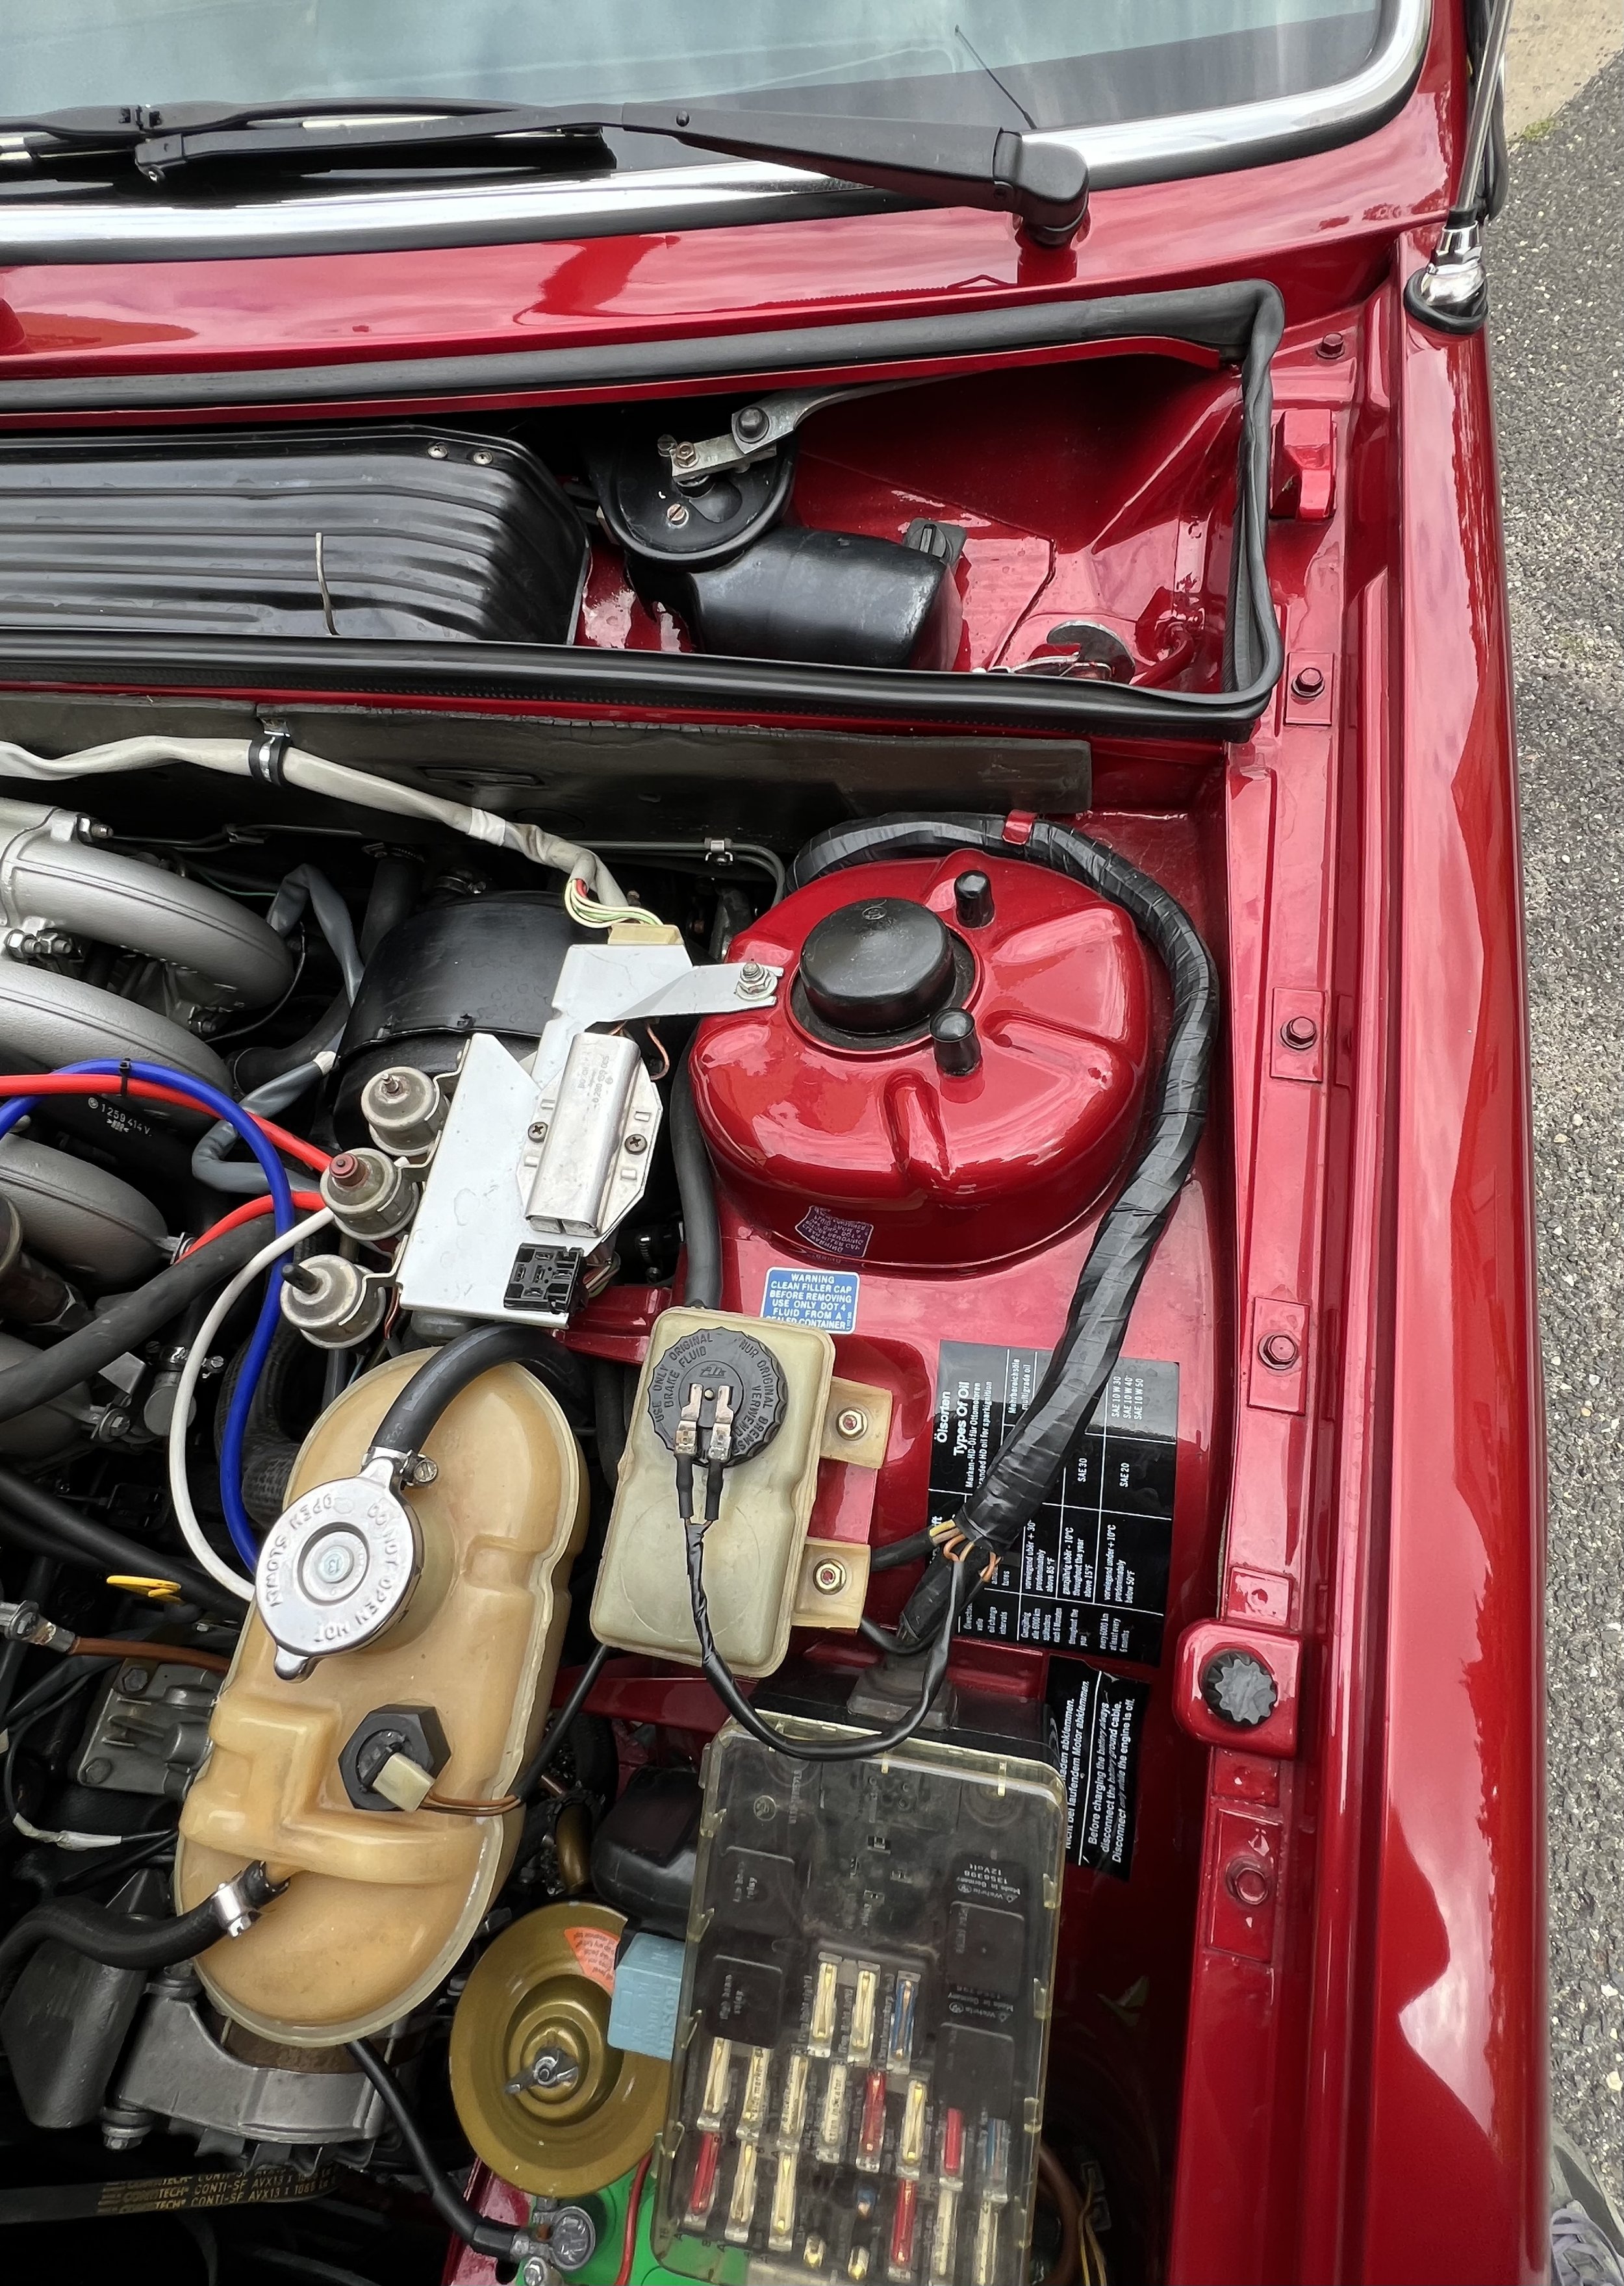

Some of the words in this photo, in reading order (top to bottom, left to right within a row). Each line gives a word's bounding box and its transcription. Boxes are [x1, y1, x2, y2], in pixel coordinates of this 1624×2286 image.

[107, 1107, 126, 1123] 259
[791, 1274, 835, 1284] WARNING
[770, 1282, 800, 1290] CLEAN
[802, 1284, 831, 1292] FILLER
[834, 1285, 852, 1293] CAP
[770, 1290, 804, 1300] BEFORE
[806, 1292, 852, 1303] REMOVING
[794, 1301, 816, 1310] ONLY
[773, 1308, 800, 1317] FLUID
[805, 1310, 831, 1319] FROM
[796, 1317, 846, 1329] CONTAINER
[669, 1332, 713, 1361] ORIGINAL
[739, 1340, 759, 1358] NUR
[757, 1360, 774, 1410] ORIGINAL
[1022, 1364, 1032, 1373] oil
[653, 1364, 670, 1391] ONLY
[665, 1369, 679, 1408] BRAKE
[679, 1346, 707, 1367] FLUID
[1113, 1376, 1122, 1386] 30
[1135, 1378, 1144, 1388] 50
[958, 1381, 970, 1399] Oil
[955, 1401, 969, 1417] Of
[969, 1382, 981, 1426] Ottomotoren
[982, 1381, 993, 1427] sparkignition
[1111, 1403, 1121, 1418] SAE
[1123, 1404, 1132, 1419] SAE
[652, 1401, 665, 1423] USE
[933, 1391, 951, 1443] Ölsorten
[1134, 1406, 1143, 1420] SAE
[953, 1420, 969, 1456] Types
[969, 1425, 978, 1438] für
[980, 1427, 989, 1438] for
[980, 1438, 988, 1448] oil
[978, 1449, 987, 1460] HD
[1078, 1458, 1087, 1468] 30
[1120, 1462, 1130, 1473] 20
[1077, 1467, 1087, 1482] SAE
[1119, 1473, 1129, 1488] SAE
[354, 1578, 392, 1626] OPEN
[1124, 1699, 1136, 1711] off.
[1111, 1701, 1123, 1729] cable.
[1124, 1712, 1132, 1721] is
[1060, 1698, 1074, 1751] abklemmen.
[1072, 1730, 1084, 1757] Motor
[1121, 1723, 1131, 1755] engine
[1095, 1756, 1105, 1770] the
[1067, 1758, 1080, 1807] laufendem
[1092, 1771, 1107, 1812] charging
[1106, 1784, 1115, 1799] the
[1087, 1813, 1100, 1845] Before
[1101, 1800, 1115, 1853] disconnect
[1111, 1808, 1126, 1863] Disconnect
[956, 1876, 987, 1887] Germany
[1000, 1885, 1021, 1894] Made
